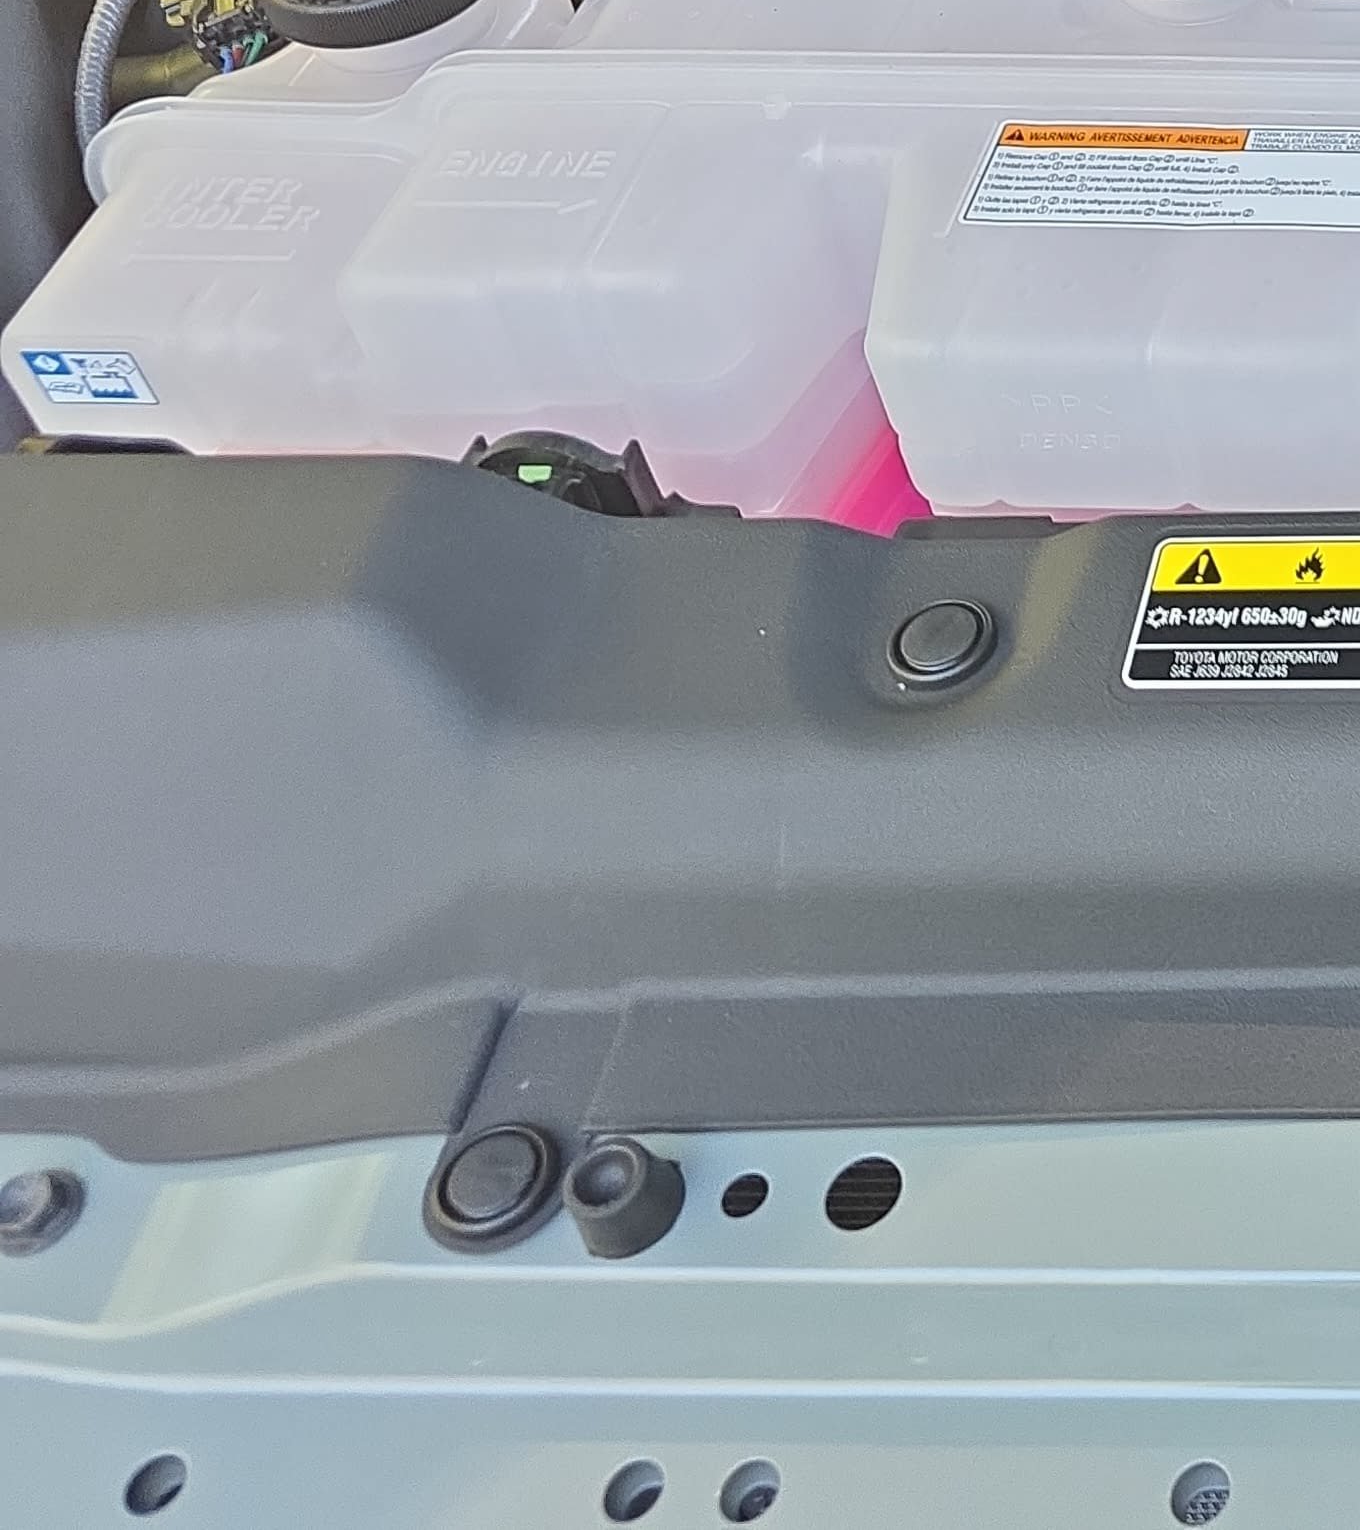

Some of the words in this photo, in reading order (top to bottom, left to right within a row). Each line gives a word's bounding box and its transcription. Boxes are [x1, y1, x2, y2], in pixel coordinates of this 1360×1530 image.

[1029, 132, 1086, 142] WARNING
[1089, 132, 1172, 143] AVERTISSEMENT
[1176, 134, 1239, 145] ADVERTENCIA
[439, 149, 617, 178] ENGINE
[1169, 606, 1240, 629] R-1234yf
[1240, 606, 1308, 629] 650±30g
[1174, 650, 1216, 664] TOYOTA
[1217, 650, 1259, 664] MOTOR
[1260, 651, 1339, 665] CORPORATION
